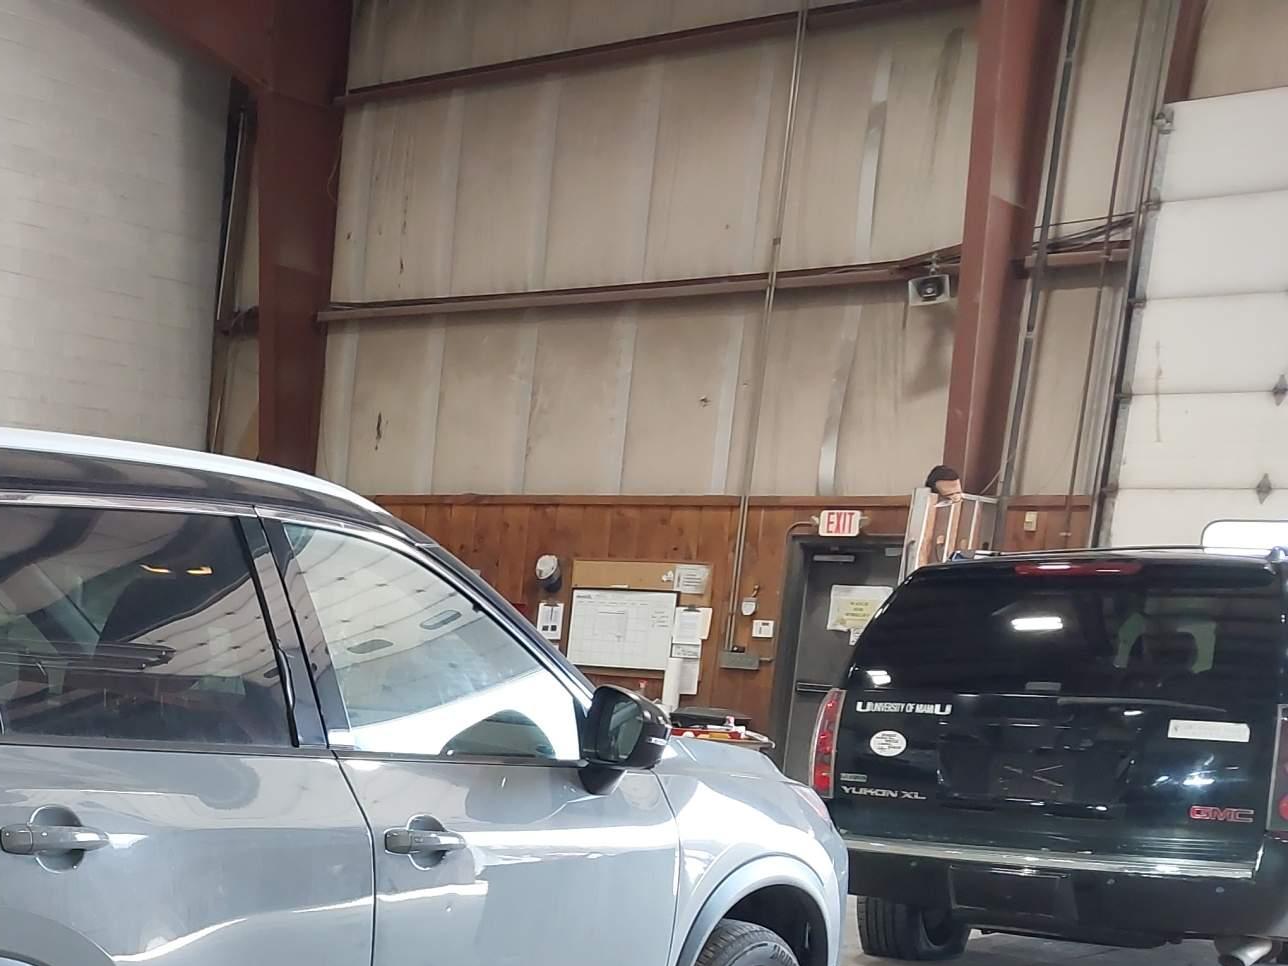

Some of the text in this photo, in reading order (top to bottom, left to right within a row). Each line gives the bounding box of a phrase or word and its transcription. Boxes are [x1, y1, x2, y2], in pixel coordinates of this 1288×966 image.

[826, 511, 855, 534] EXIT
[906, 703, 915, 713] OF
[841, 786, 926, 799] YUKON XL
[1190, 805, 1254, 823] GMC
